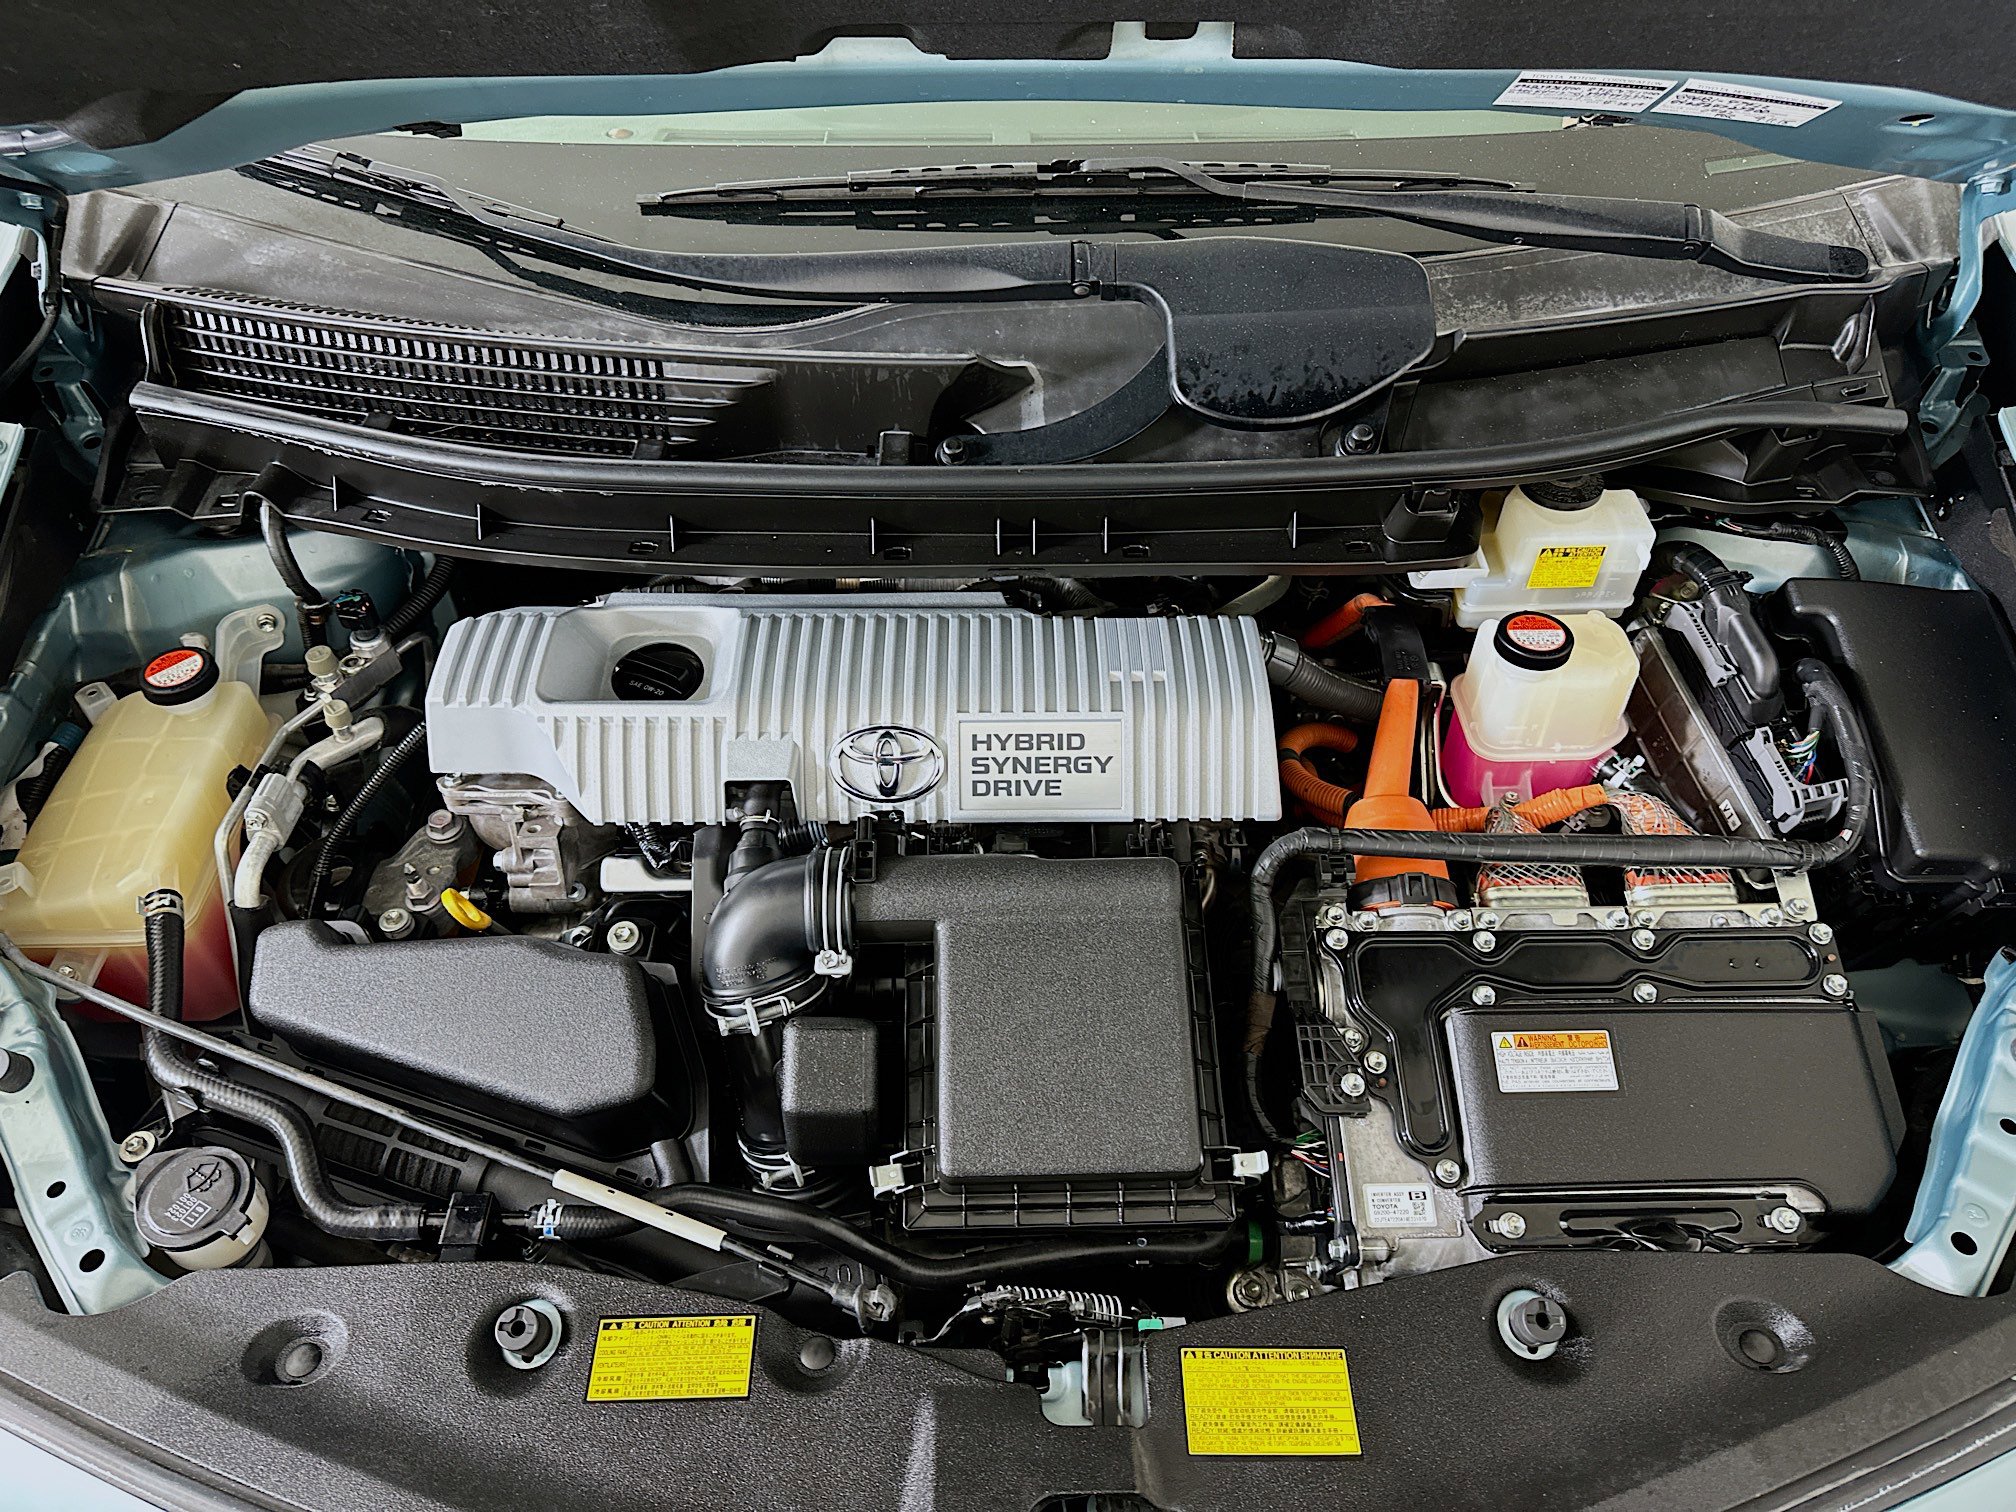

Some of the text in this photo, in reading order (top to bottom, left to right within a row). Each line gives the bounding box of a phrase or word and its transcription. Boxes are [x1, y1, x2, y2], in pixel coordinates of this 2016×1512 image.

[1602, 77, 1663, 86] CORPORATION
[629, 680, 664, 696] SAE 0W-20
[972, 734, 1086, 751] HYBRID
[972, 756, 1114, 774] SYNERGY
[972, 780, 1062, 796] DRIVE
[1412, 1191, 1424, 1200] B
[639, 1320, 710, 1329] CAUTION ATTENTION
[1252, 1352, 1298, 1360] ATTENTION
[1300, 1352, 1343, 1360] ВНИМАНИЕ
